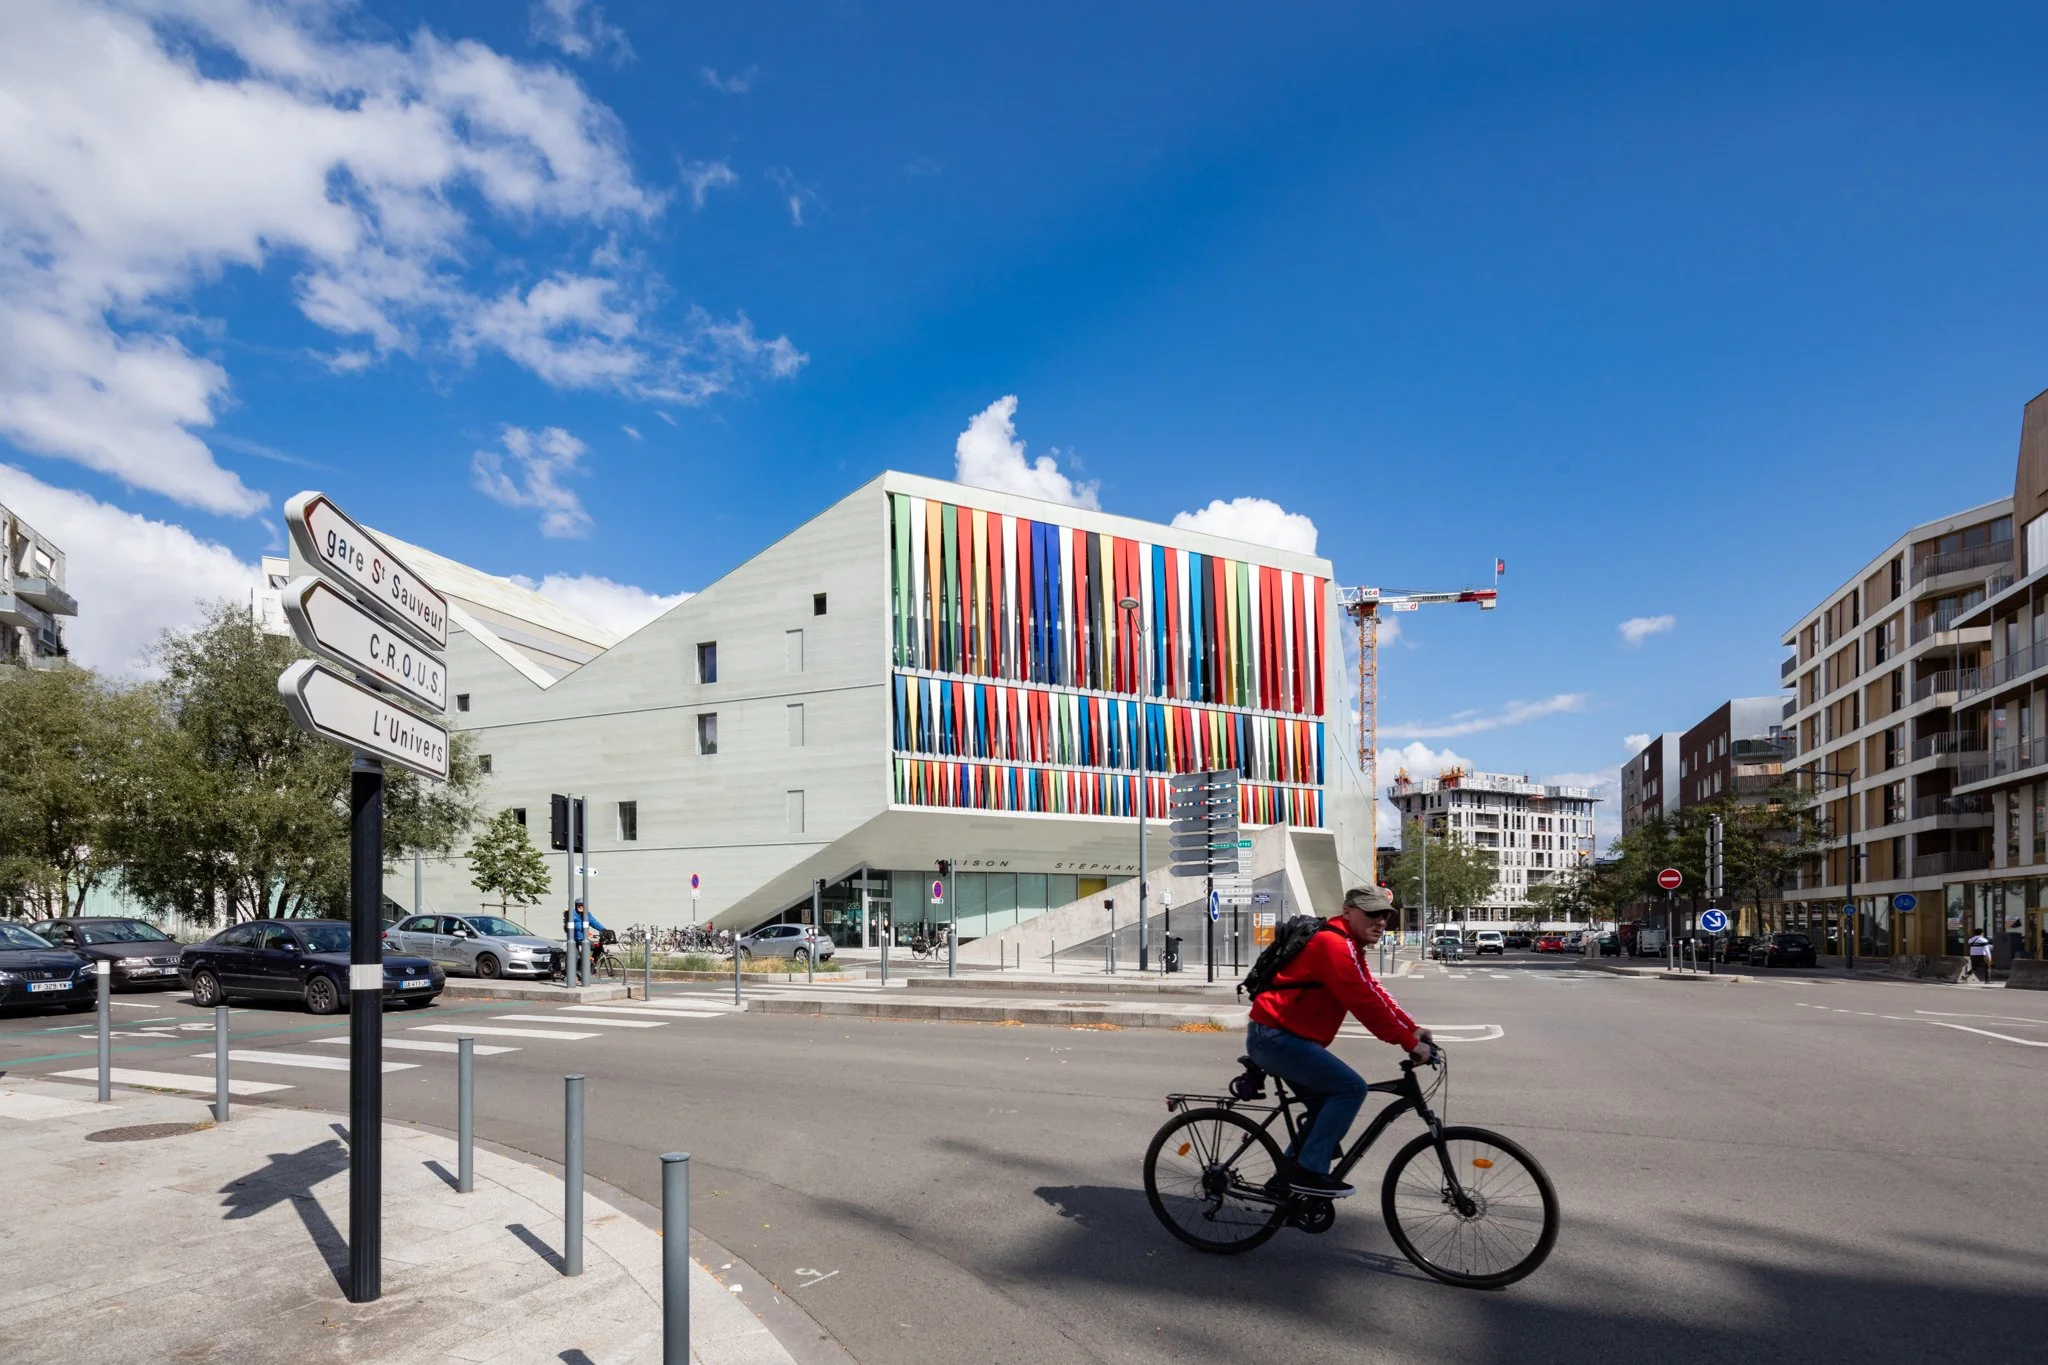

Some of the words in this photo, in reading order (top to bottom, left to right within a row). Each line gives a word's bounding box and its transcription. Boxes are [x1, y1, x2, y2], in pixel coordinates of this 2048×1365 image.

[327, 529, 364, 572] gare
[391, 574, 443, 633] Sauveur
[370, 633, 442, 696] C.R.O.U.S.
[373, 709, 443, 763] L'Univers
[1054, 862, 1140, 871] STEPHAN
